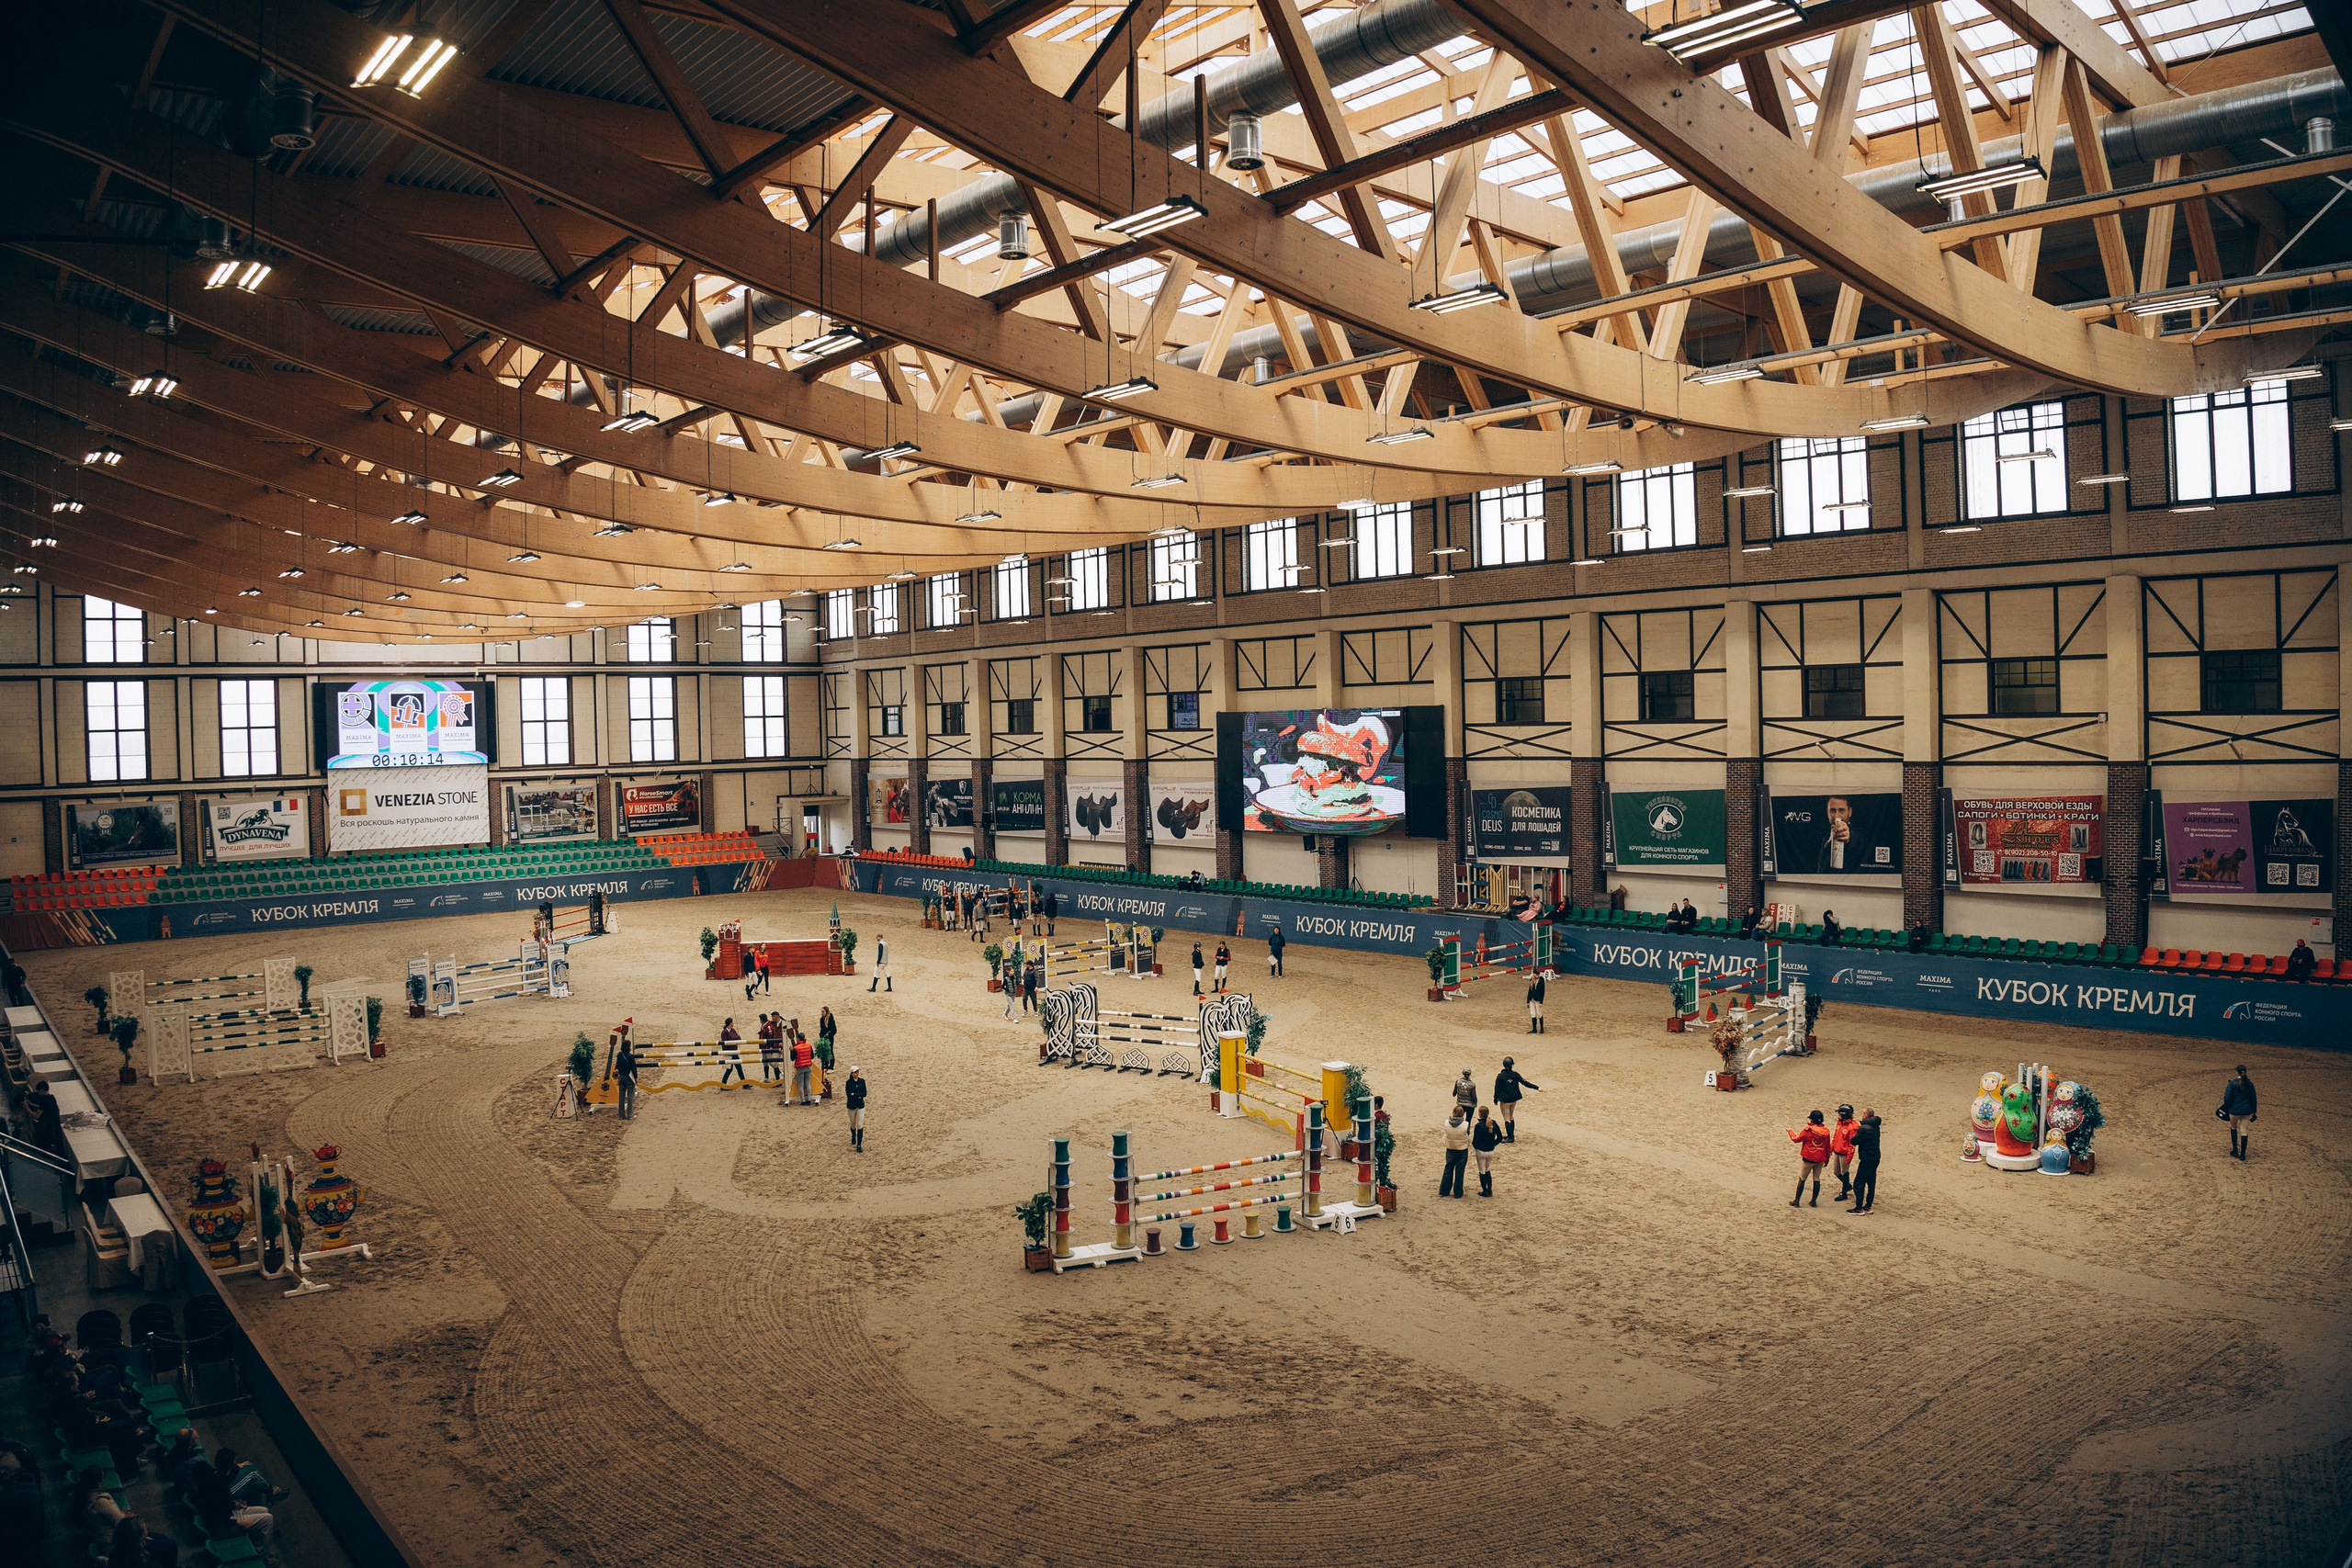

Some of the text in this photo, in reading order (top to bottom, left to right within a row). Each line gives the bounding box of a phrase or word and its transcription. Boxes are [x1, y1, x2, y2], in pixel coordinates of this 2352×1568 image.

[372, 753, 444, 766] 00:10:14
[375, 791, 478, 807] VENEZIA STONE
[1013, 792, 1042, 803] КОРМА
[628, 803, 678, 814] У НАС ЕСТЬ ВСЕ
[1012, 804, 1042, 814] АНИЛИН
[1995, 801, 2013, 809] ДЛЯ
[2016, 800, 2064, 810] ВЕРХОВОЙ
[2066, 803, 2092, 811] ЕЗДЫ
[1482, 810, 1502, 819] COSMO
[1511, 807, 1561, 818] КОСМЕТИКА
[357, 819, 394, 828] роскошь
[397, 816, 452, 825] натурального
[1482, 819, 1502, 831] DEUS
[1511, 821, 1561, 833] ДЛЯ ЛОШАДЕЙ
[228, 829, 281, 842] DYNAVENA
[2016, 836, 2059, 844] SHOES
[516, 880, 628, 902] КУБОК КРЕМЛЯ
[252, 900, 379, 922] КУБОК КРЕМЛЯ
[1078, 895, 1165, 917] КУБОК КРЕМЛЯ
[1295, 915, 1415, 942] КУБОК КРЕМЛЯ
[1594, 943, 1662, 969] КУБОК
[1781, 963, 1808, 971] MAXIMA
[1919, 975, 1951, 983] MAXIMA
[1977, 977, 2196, 1018] КУБОК КРЕМЛЯ
[1709, 1074, 1713, 1083] 5
[1335, 1216, 1340, 1229] 6
[1346, 1216, 1351, 1229] 6
